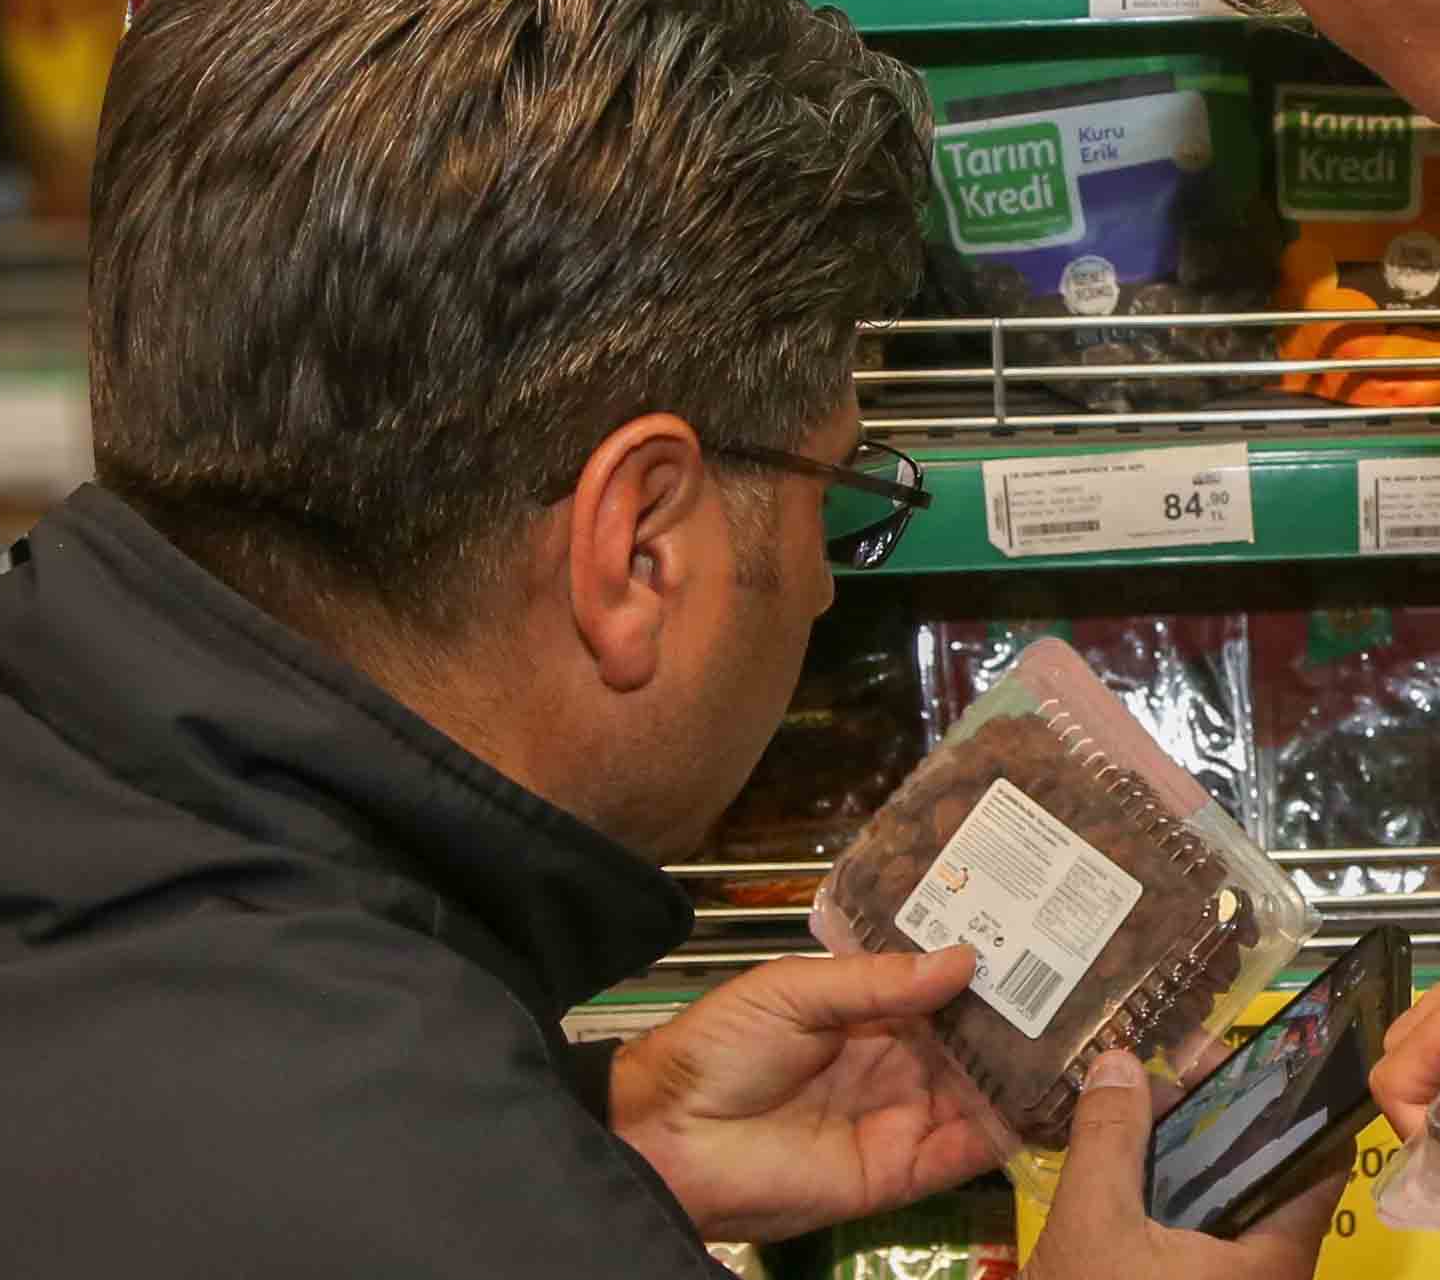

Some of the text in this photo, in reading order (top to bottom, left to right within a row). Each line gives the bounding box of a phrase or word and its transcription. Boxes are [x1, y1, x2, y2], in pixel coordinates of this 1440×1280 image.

[1078, 125, 1126, 146] Kuru
[1079, 143, 1119, 166] Erik
[943, 139, 1056, 179] Tarım
[1298, 145, 1396, 183] Kredi
[960, 182, 1054, 220] Kredi
